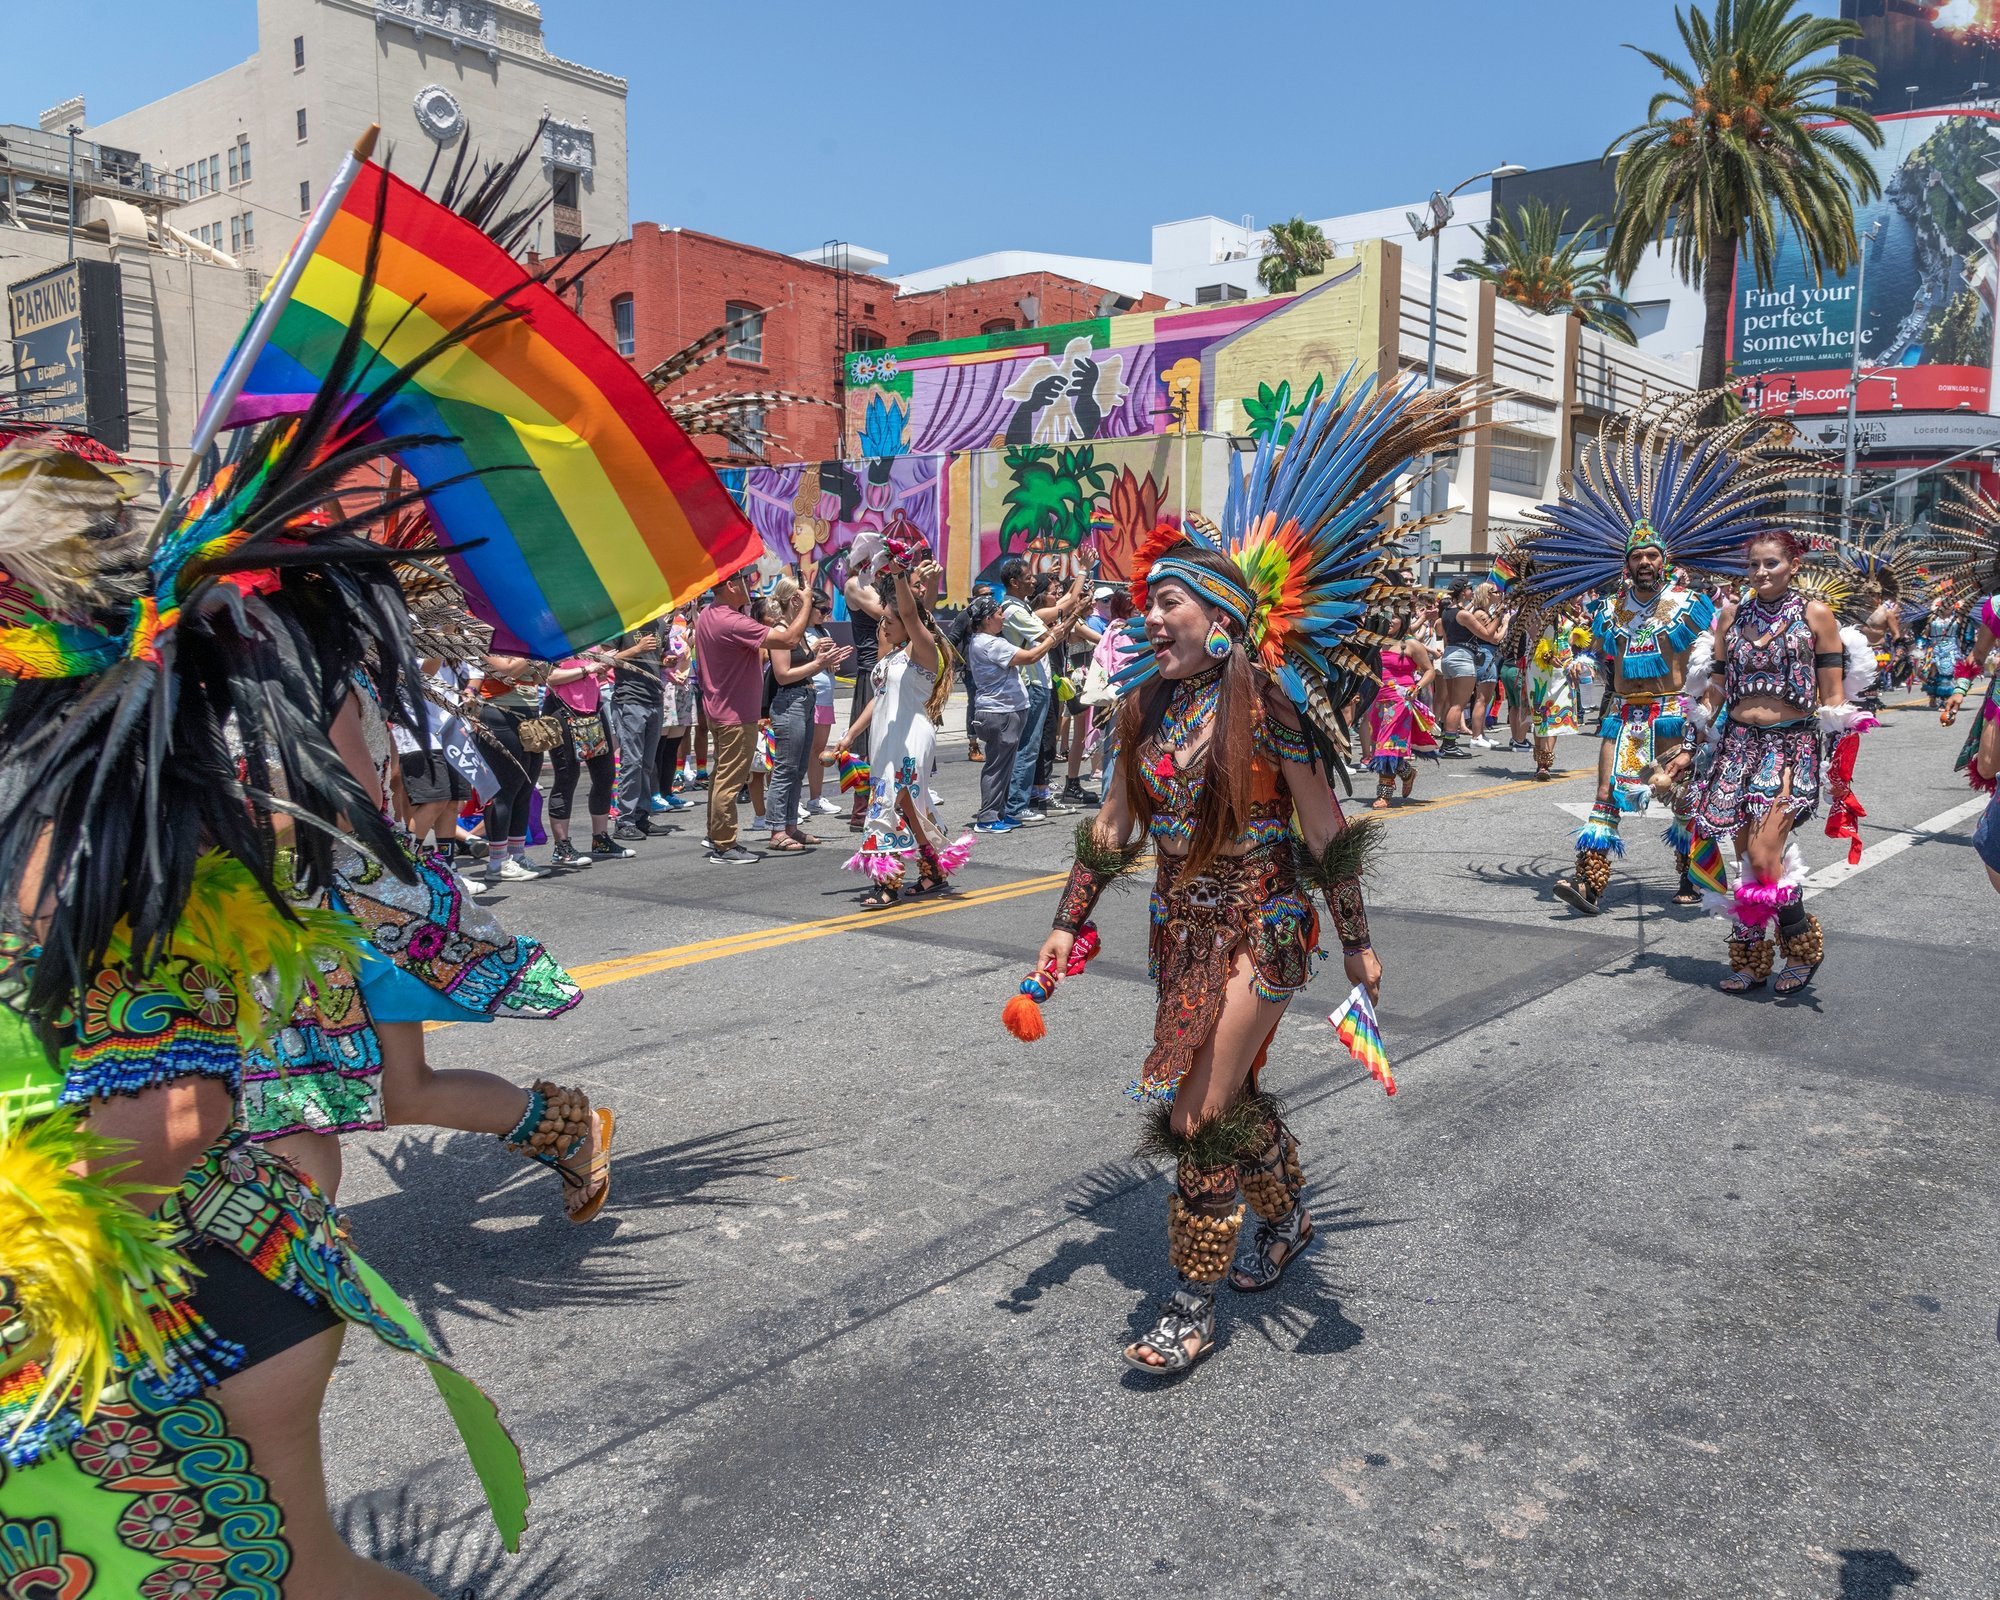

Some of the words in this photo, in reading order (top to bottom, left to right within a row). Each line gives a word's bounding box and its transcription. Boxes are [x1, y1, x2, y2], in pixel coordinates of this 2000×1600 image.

[15, 276, 76, 330] PARKING
[1744, 284, 1795, 309] Find
[1801, 285, 1855, 309] your
[1743, 306, 1825, 336] perfect
[1743, 358, 1762, 366] HOTEL
[1763, 356, 1783, 364] SANTA
[1767, 387, 1850, 403] Hoels.com
[1913, 426, 1949, 434] Located
[1951, 427, 1975, 435] inside
